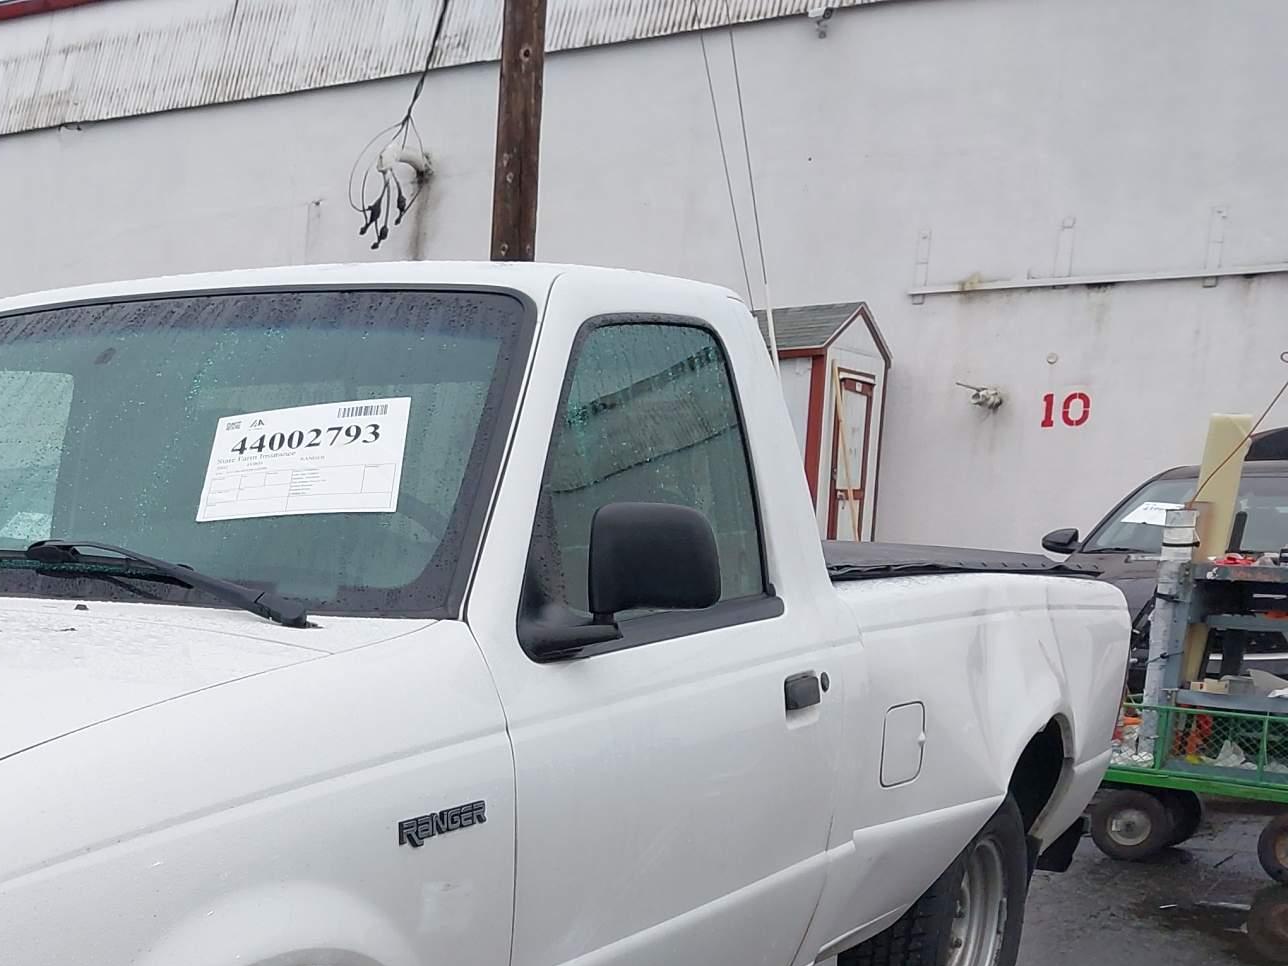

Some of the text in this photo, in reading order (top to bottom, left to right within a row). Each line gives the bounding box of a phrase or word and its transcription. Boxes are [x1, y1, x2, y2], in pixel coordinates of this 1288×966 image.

[1041, 392, 1091, 428] 10
[230, 423, 381, 455] 44002793
[398, 800, 487, 848] RANGER
